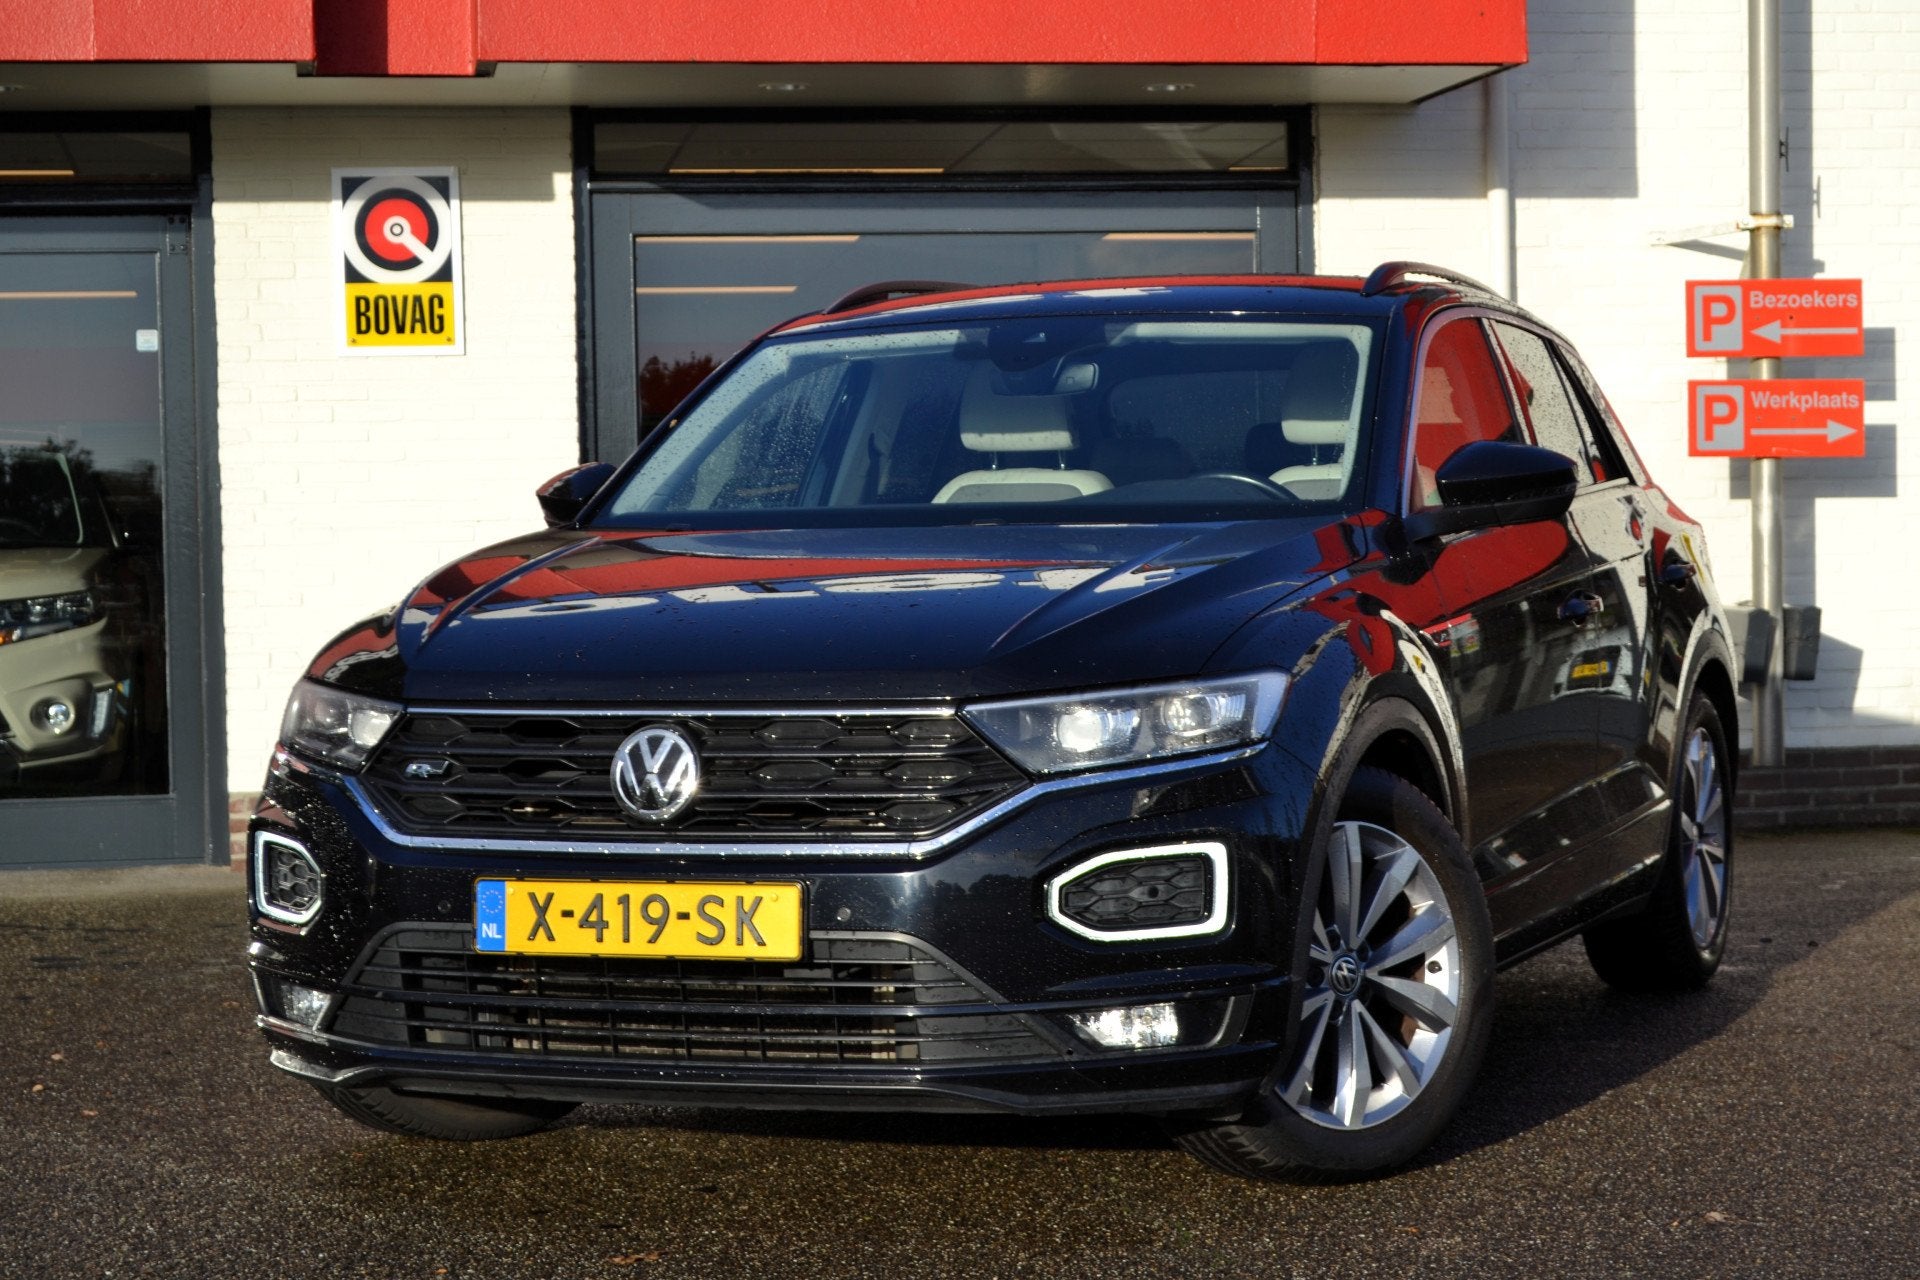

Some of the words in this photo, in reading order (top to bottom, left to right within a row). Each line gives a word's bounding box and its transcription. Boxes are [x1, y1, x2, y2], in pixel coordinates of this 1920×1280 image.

[355, 294, 445, 335] BOVAG
[1702, 294, 1736, 342] P
[1750, 290, 1858, 308] Bezoekers
[1704, 394, 1738, 442] P
[1751, 391, 1860, 412] Werkplaats
[481, 922, 502, 939] NL
[527, 891, 767, 947] X-419-SK
